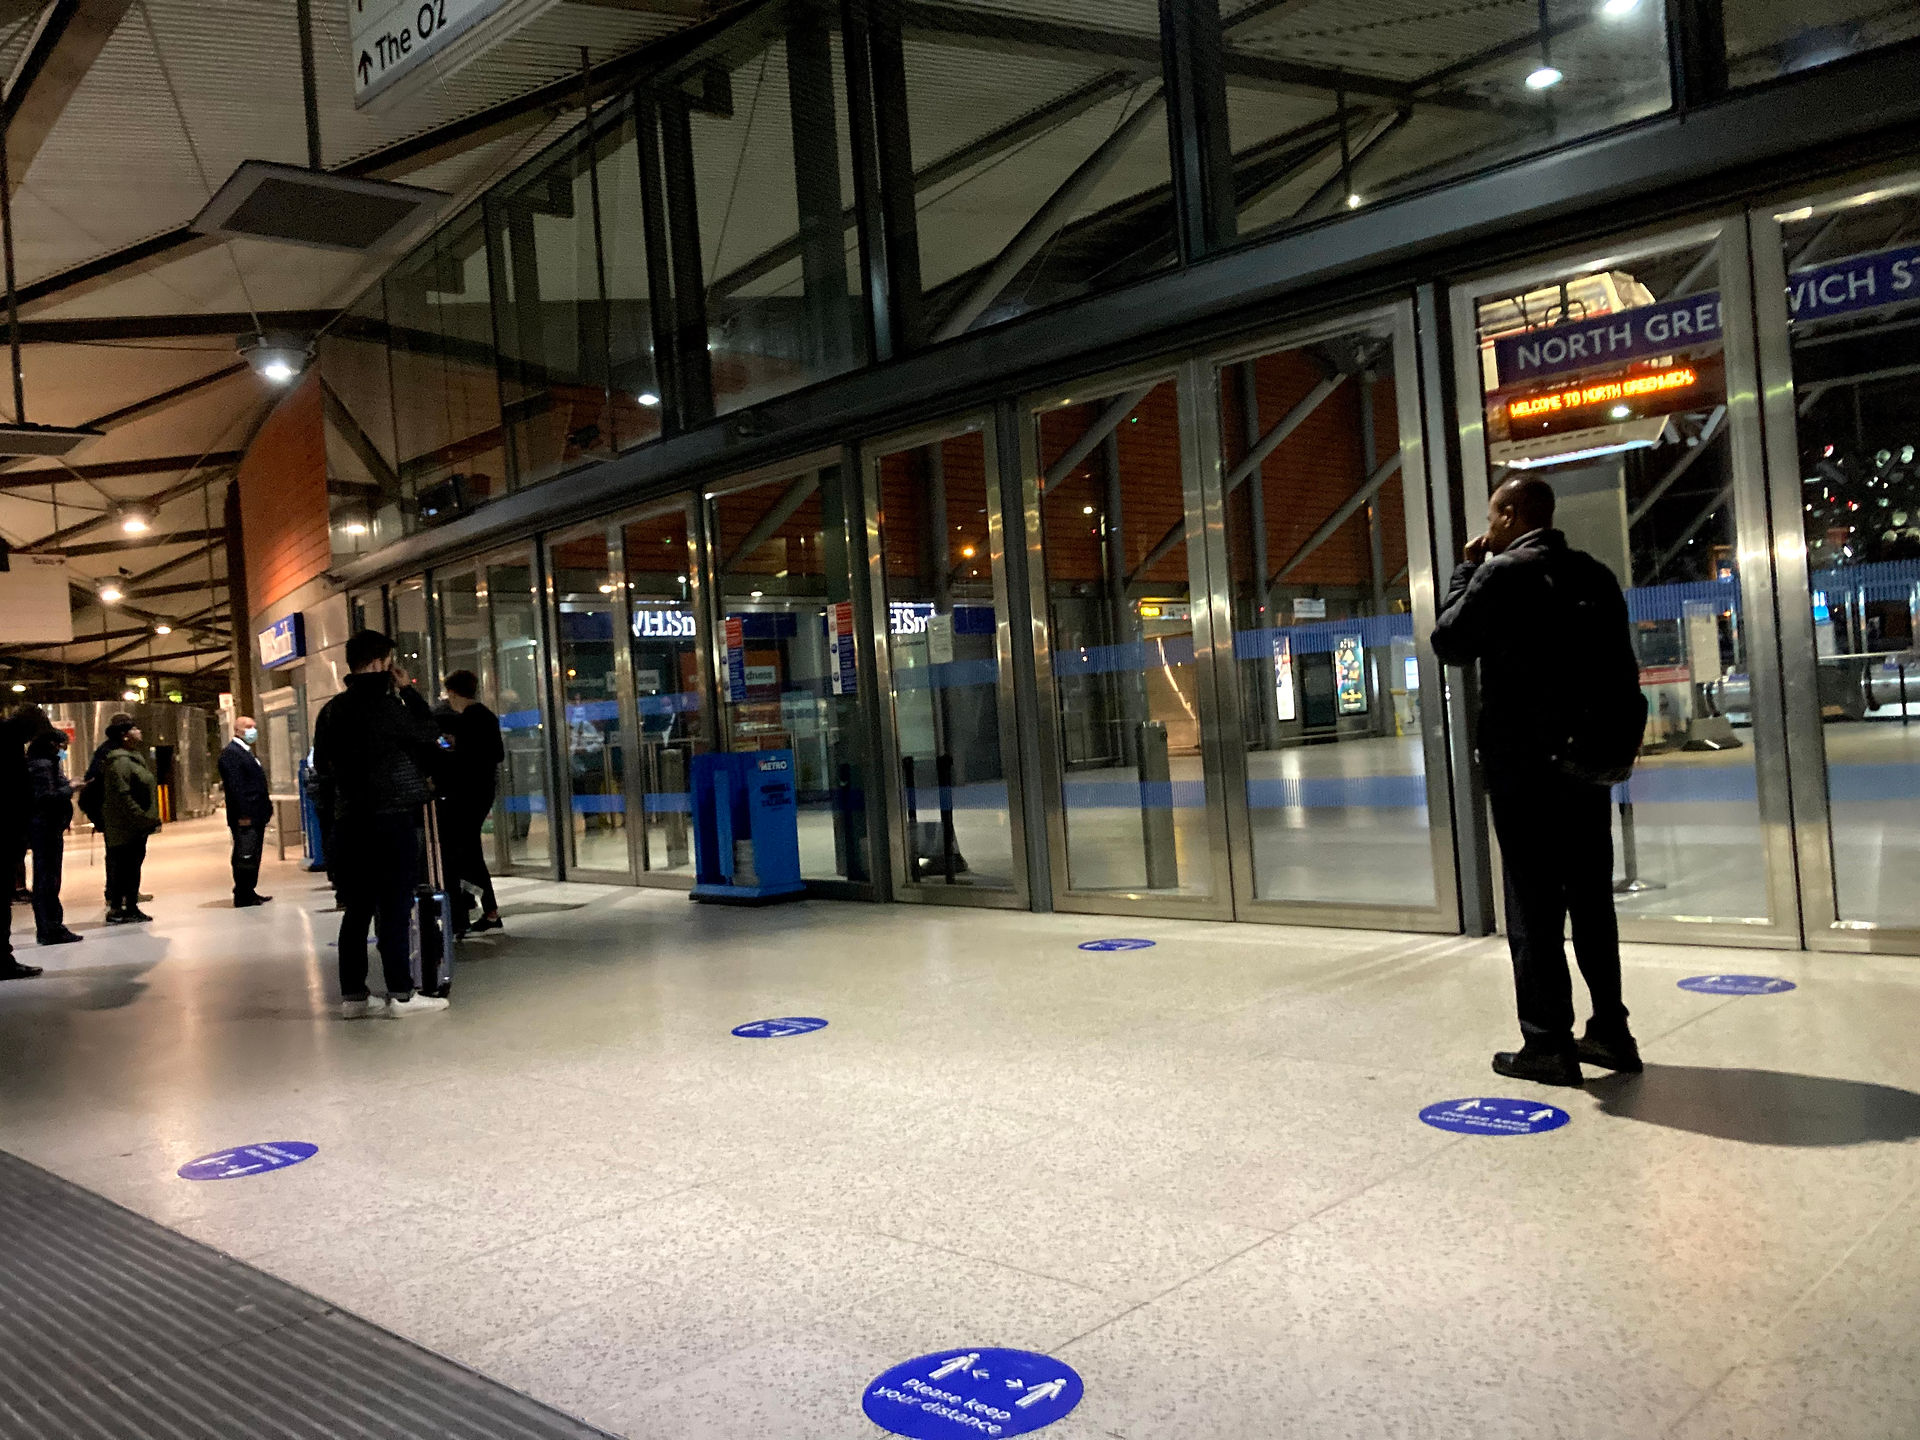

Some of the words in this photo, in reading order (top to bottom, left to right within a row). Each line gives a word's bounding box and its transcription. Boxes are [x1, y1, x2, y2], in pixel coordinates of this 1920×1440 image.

[375, 28, 412, 70] The
[1517, 322, 1632, 370] NORTH
[1510, 395, 1562, 417] WELCOME
[1563, 391, 1581, 408] TO
[1582, 383, 1621, 405] NORTH
[872, 1386, 921, 1404] your
[921, 1402, 1002, 1435] distance
[963, 1398, 1011, 1421] keep
